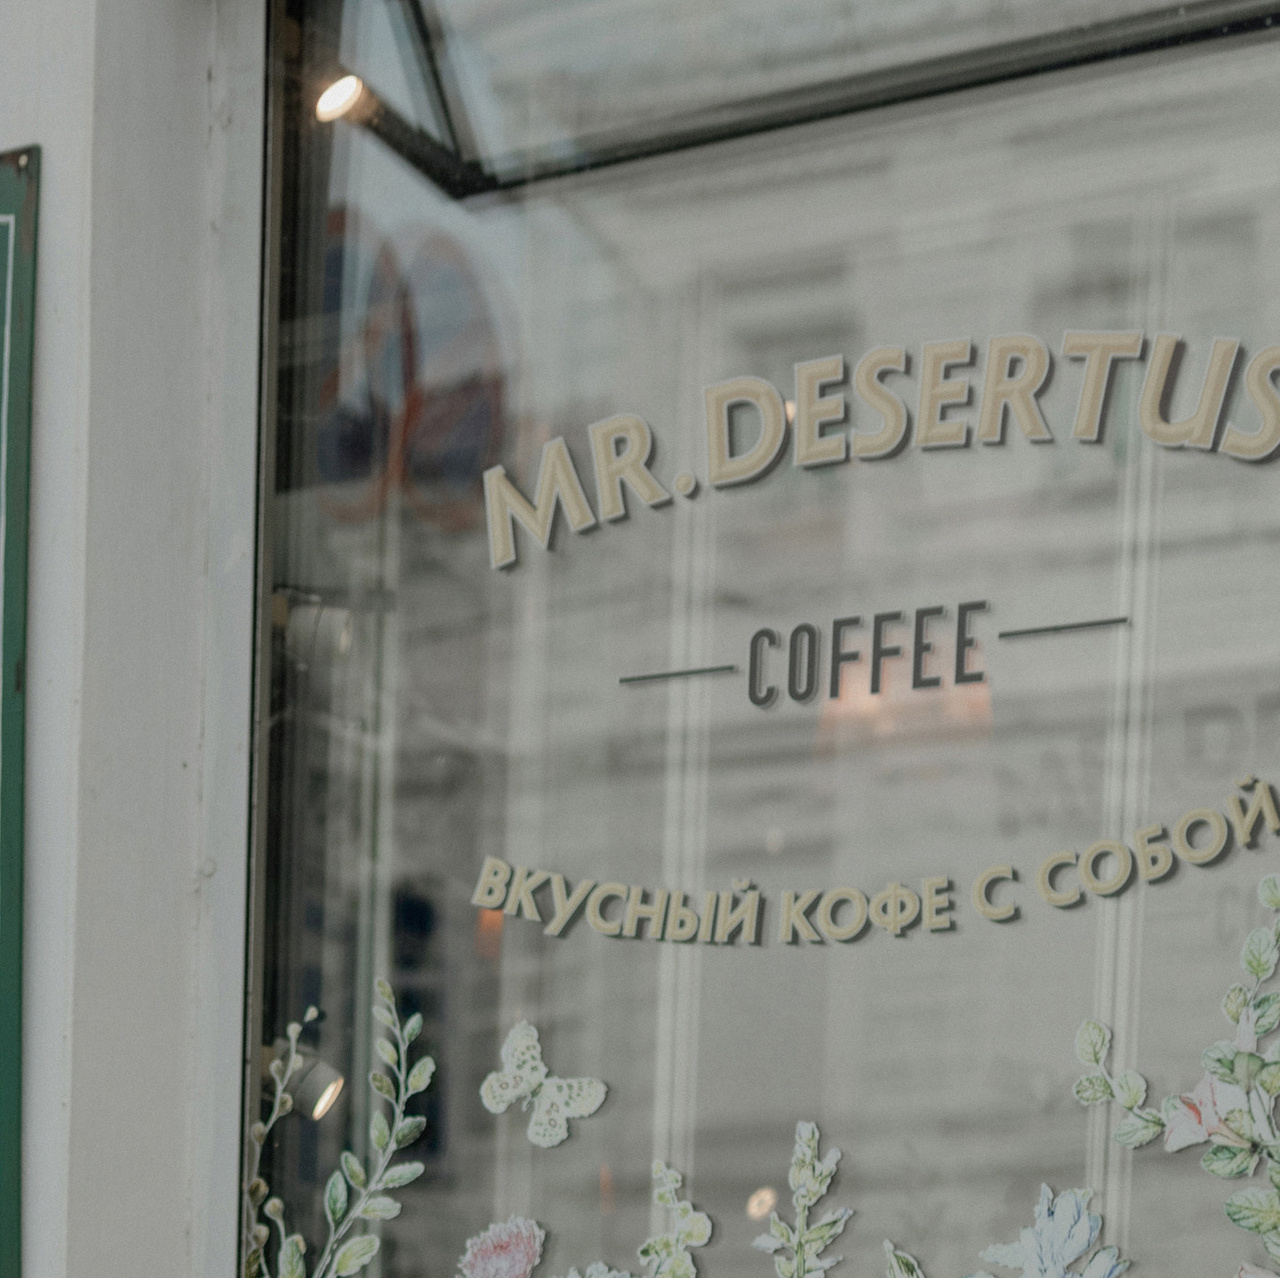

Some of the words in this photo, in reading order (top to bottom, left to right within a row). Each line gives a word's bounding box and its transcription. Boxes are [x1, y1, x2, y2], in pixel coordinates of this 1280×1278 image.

[747, 600, 989, 707] COFFEE
[472, 855, 766, 946] ВКУСНЫЙ
[779, 876, 954, 944] КОФЕ
[972, 863, 1018, 922] С
[1035, 773, 1280, 908] СОБОЙ
